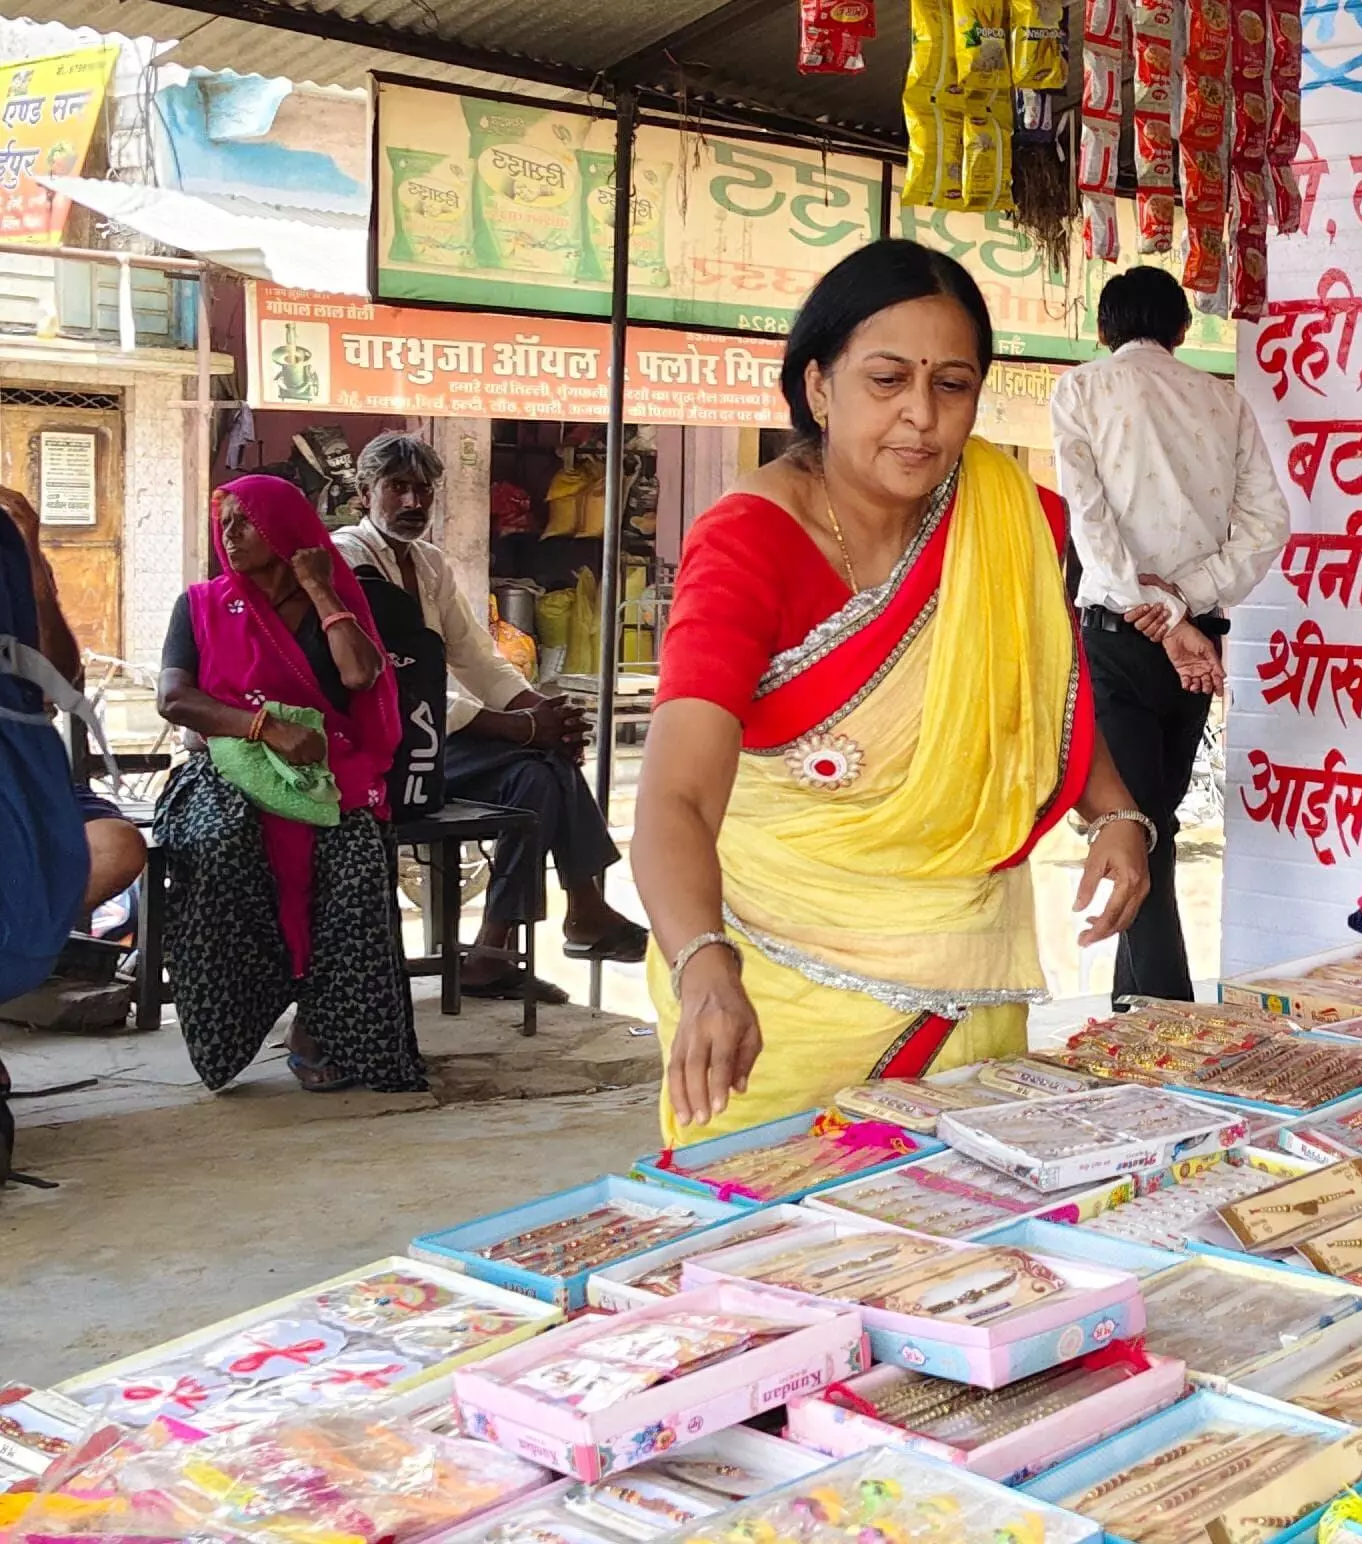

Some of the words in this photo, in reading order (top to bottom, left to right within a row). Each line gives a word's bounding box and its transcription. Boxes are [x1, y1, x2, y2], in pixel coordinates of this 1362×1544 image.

[266, 297, 311, 317] गोपाल
[314, 304, 345, 319] लाल
[340, 333, 486, 385] चारभुजा
[492, 333, 601, 380] ऑयल
[637, 344, 721, 386] फ्लोर
[403, 700, 439, 805] FILA
[763, 1369, 823, 1404] Kundan
